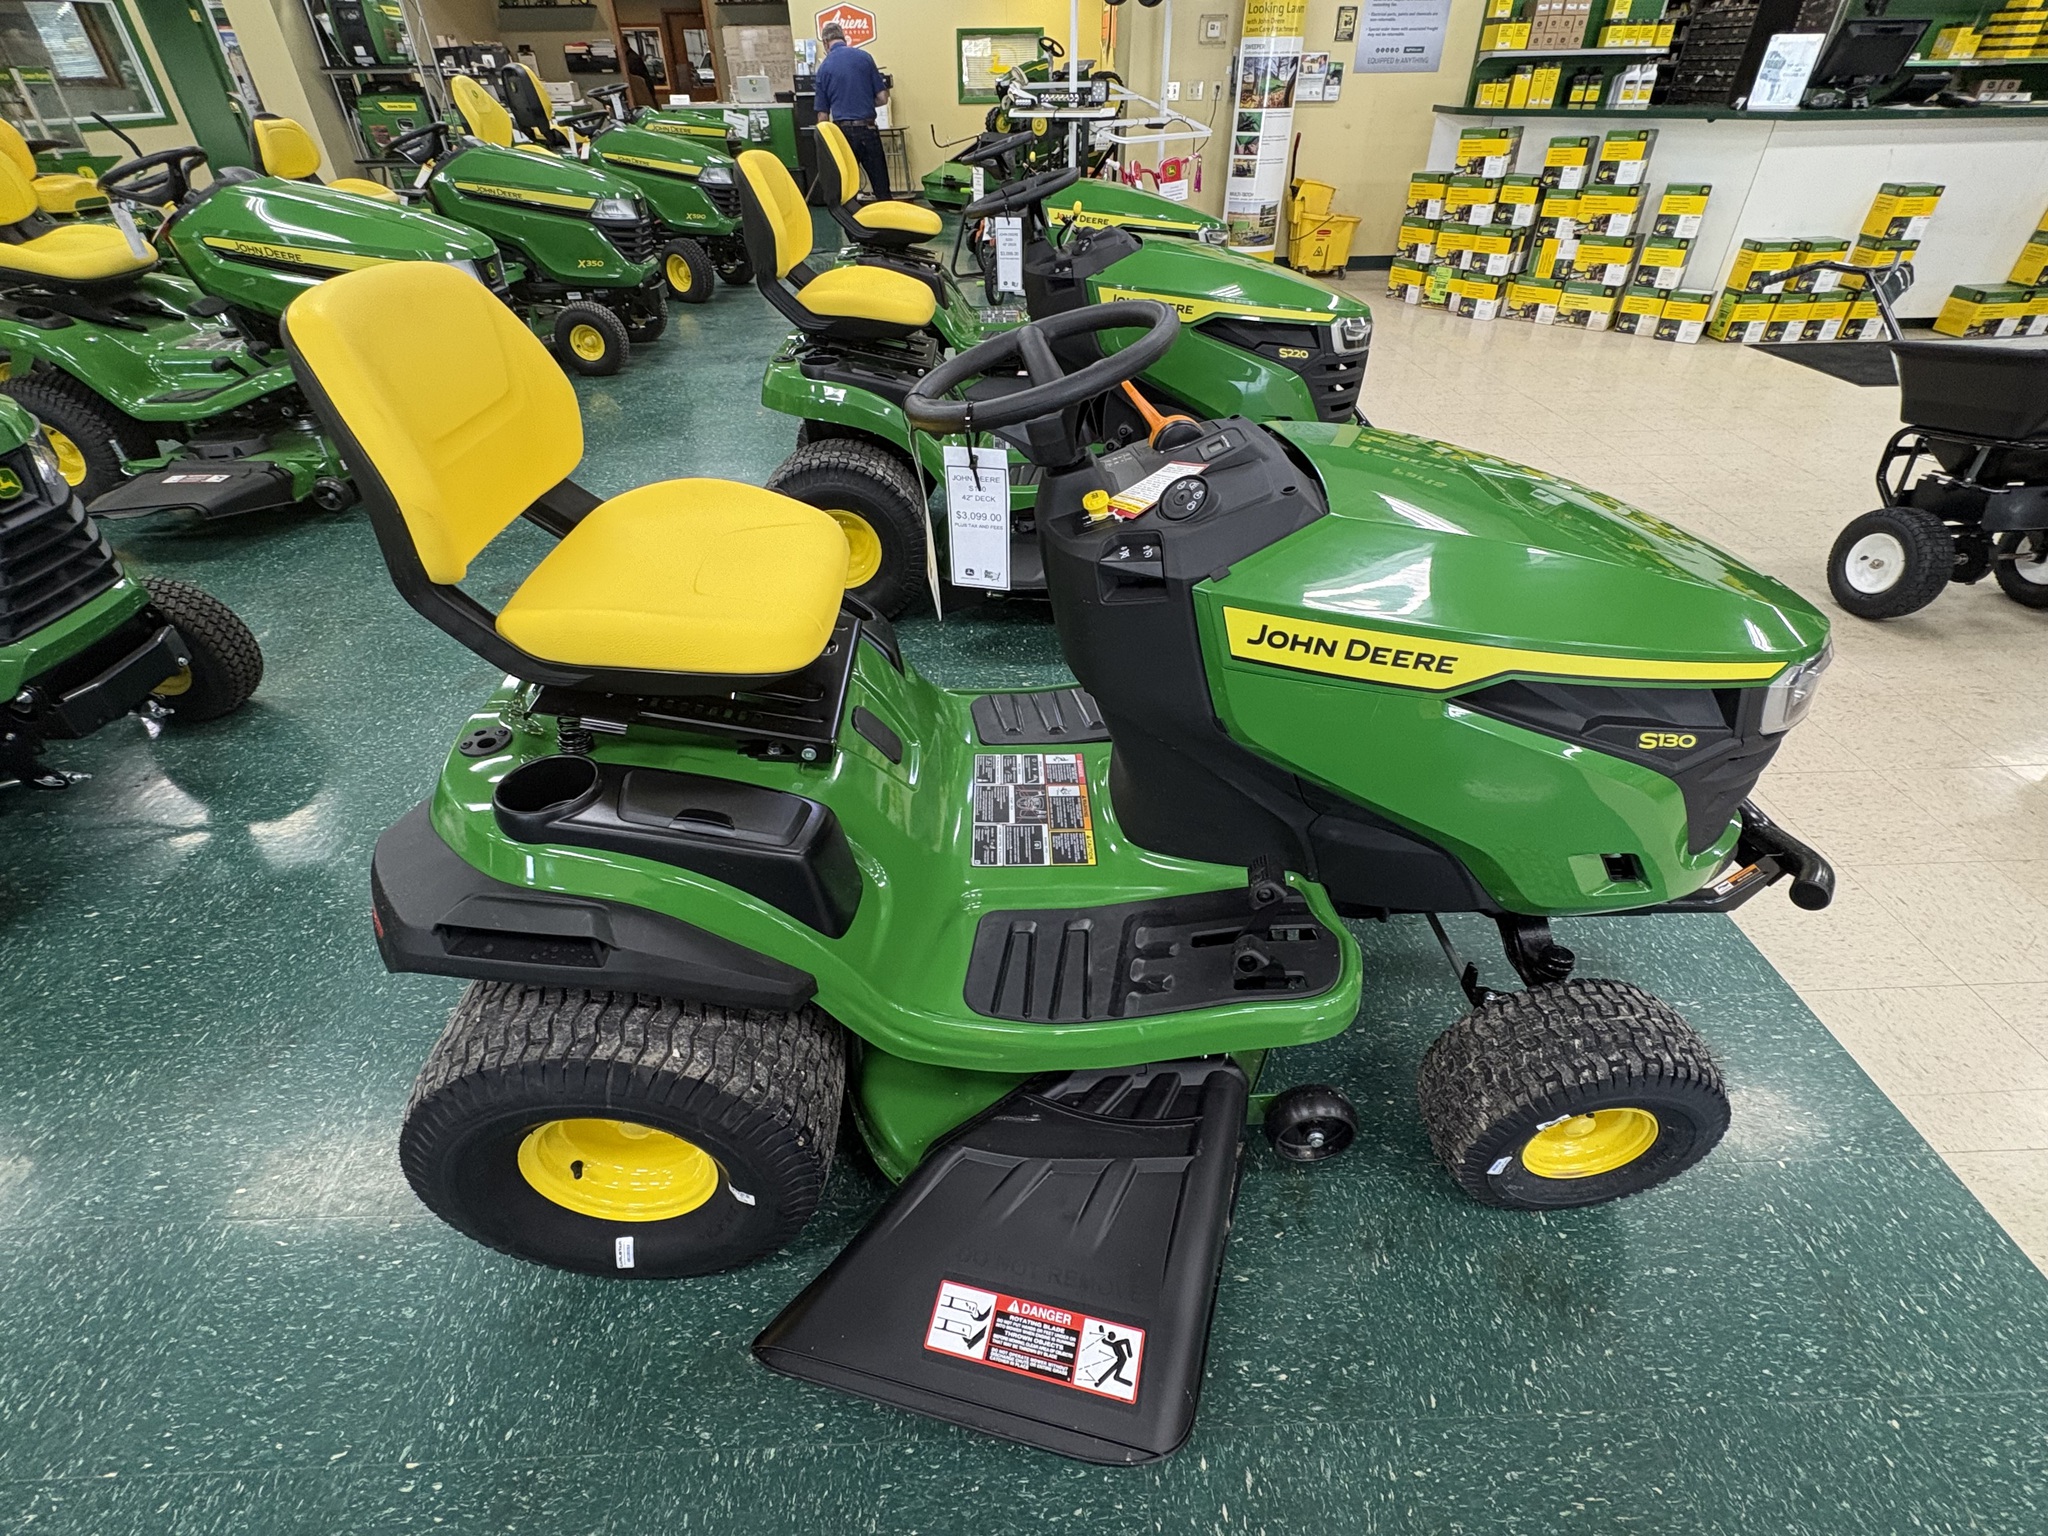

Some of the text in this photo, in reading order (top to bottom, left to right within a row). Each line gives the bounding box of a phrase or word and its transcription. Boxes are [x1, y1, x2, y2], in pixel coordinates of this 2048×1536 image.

[1248, 2, 1284, 16] Looking
[823, 10, 869, 29] Ariens
[651, 124, 691, 135] JOHN DEERE
[616, 155, 650, 167] JOHN DEERE
[476, 185, 522, 200] JOHN DEERE
[686, 212, 706, 220] X590
[1079, 214, 1110, 226] DEERE
[234, 241, 304, 262] JOHN DEERE
[578, 259, 604, 268] X350
[1278, 347, 1309, 359] S220
[952, 474, 972, 482] JOHN
[956, 510, 1002, 522] $3,099.00
[1246, 624, 1459, 674] JOHN DEERE
[1638, 732, 1697, 750] S130
[1086, 839, 1094, 860] CAUTION
[1021, 1303, 1073, 1326] DANGER
[1009, 1315, 1065, 1334] ROTATING BLADE
[1004, 1331, 1064, 1351] THROWN OBJECTS
